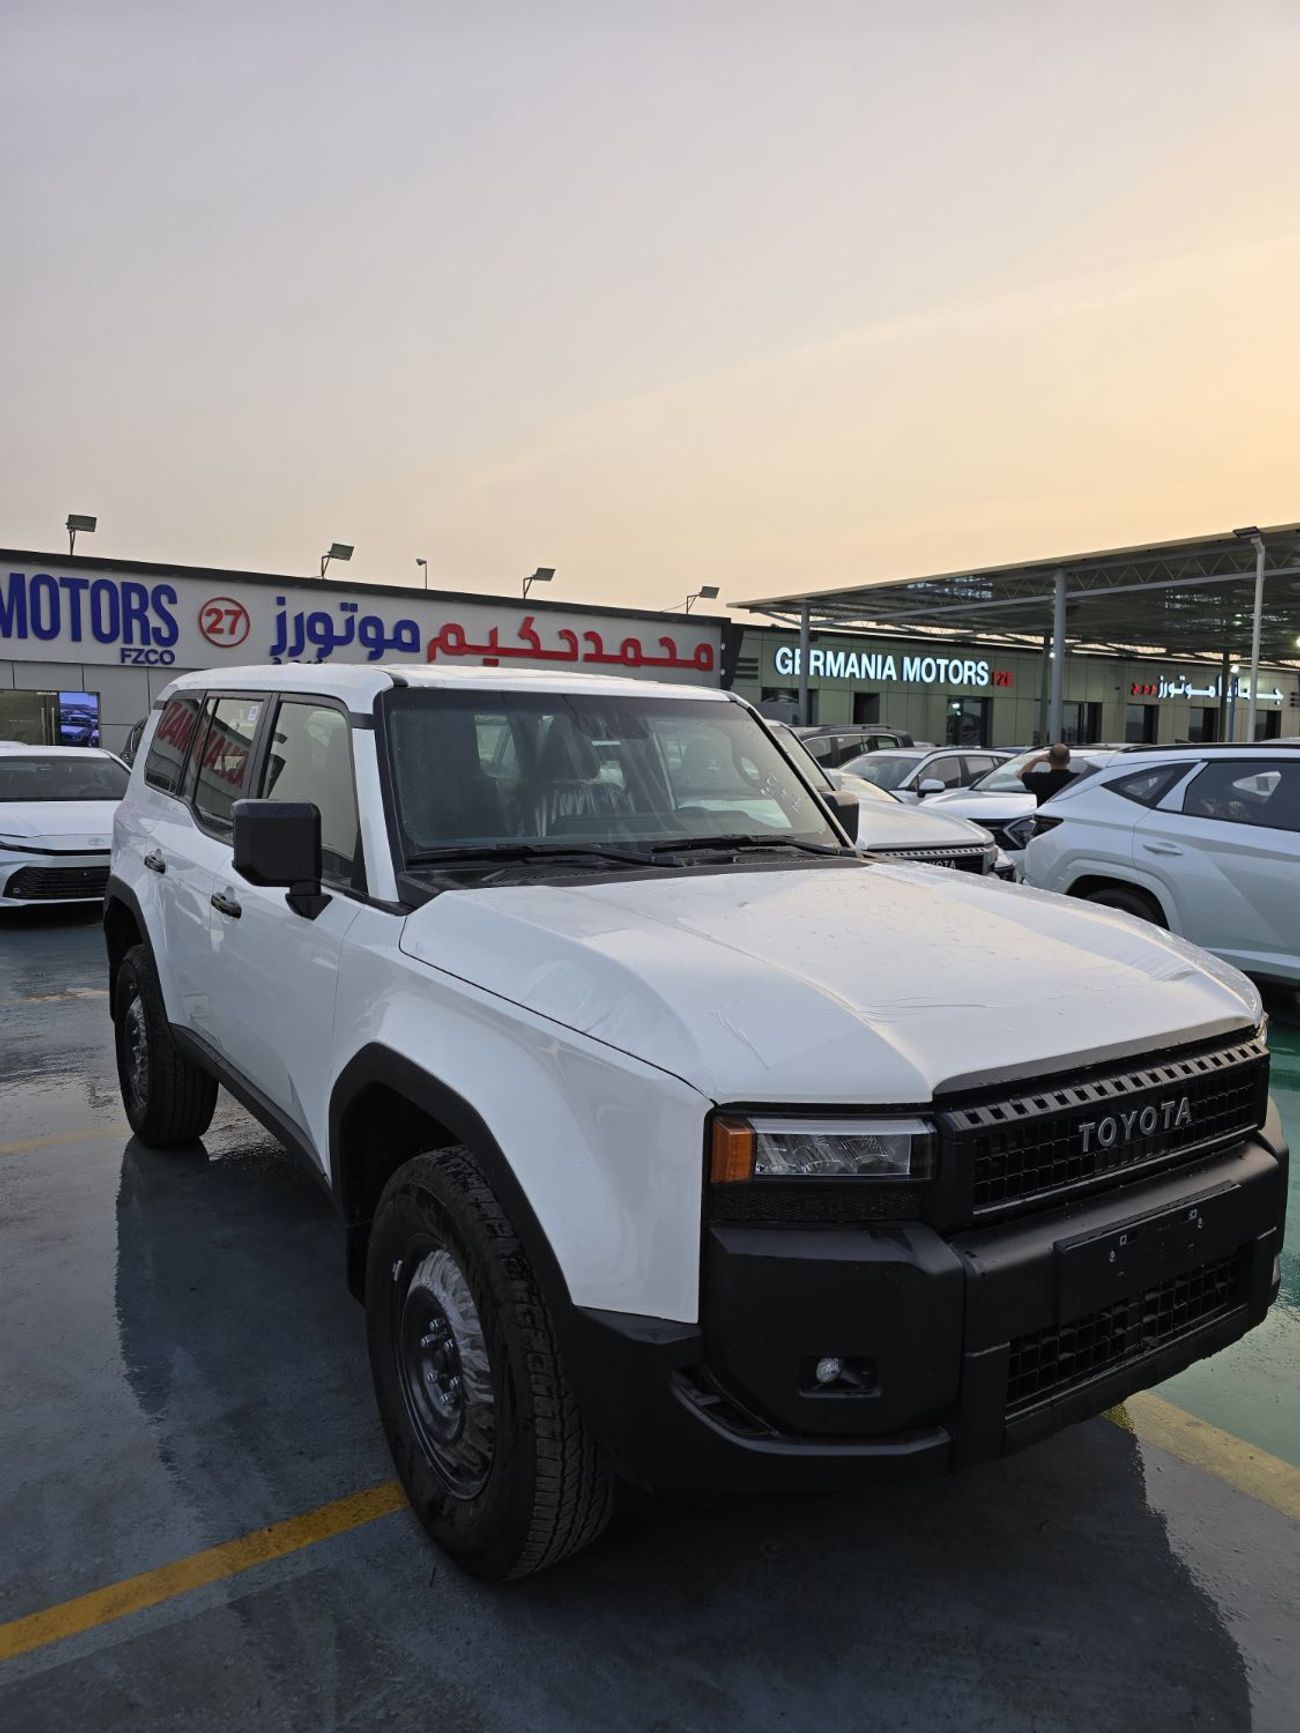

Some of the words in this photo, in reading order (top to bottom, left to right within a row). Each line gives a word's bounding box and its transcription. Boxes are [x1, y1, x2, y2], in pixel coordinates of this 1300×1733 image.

[0, 572, 179, 648] MOTORS
[205, 607, 243, 636] 27
[269, 596, 421, 661] موتورز
[120, 648, 176, 665] FZCO
[427, 616, 579, 667] حكيم
[583, 629, 715, 671] محمد
[902, 656, 989, 686] MOTORS
[1157, 674, 1216, 700] موتورز
[1078, 1096, 1193, 1152] TOYOTA
